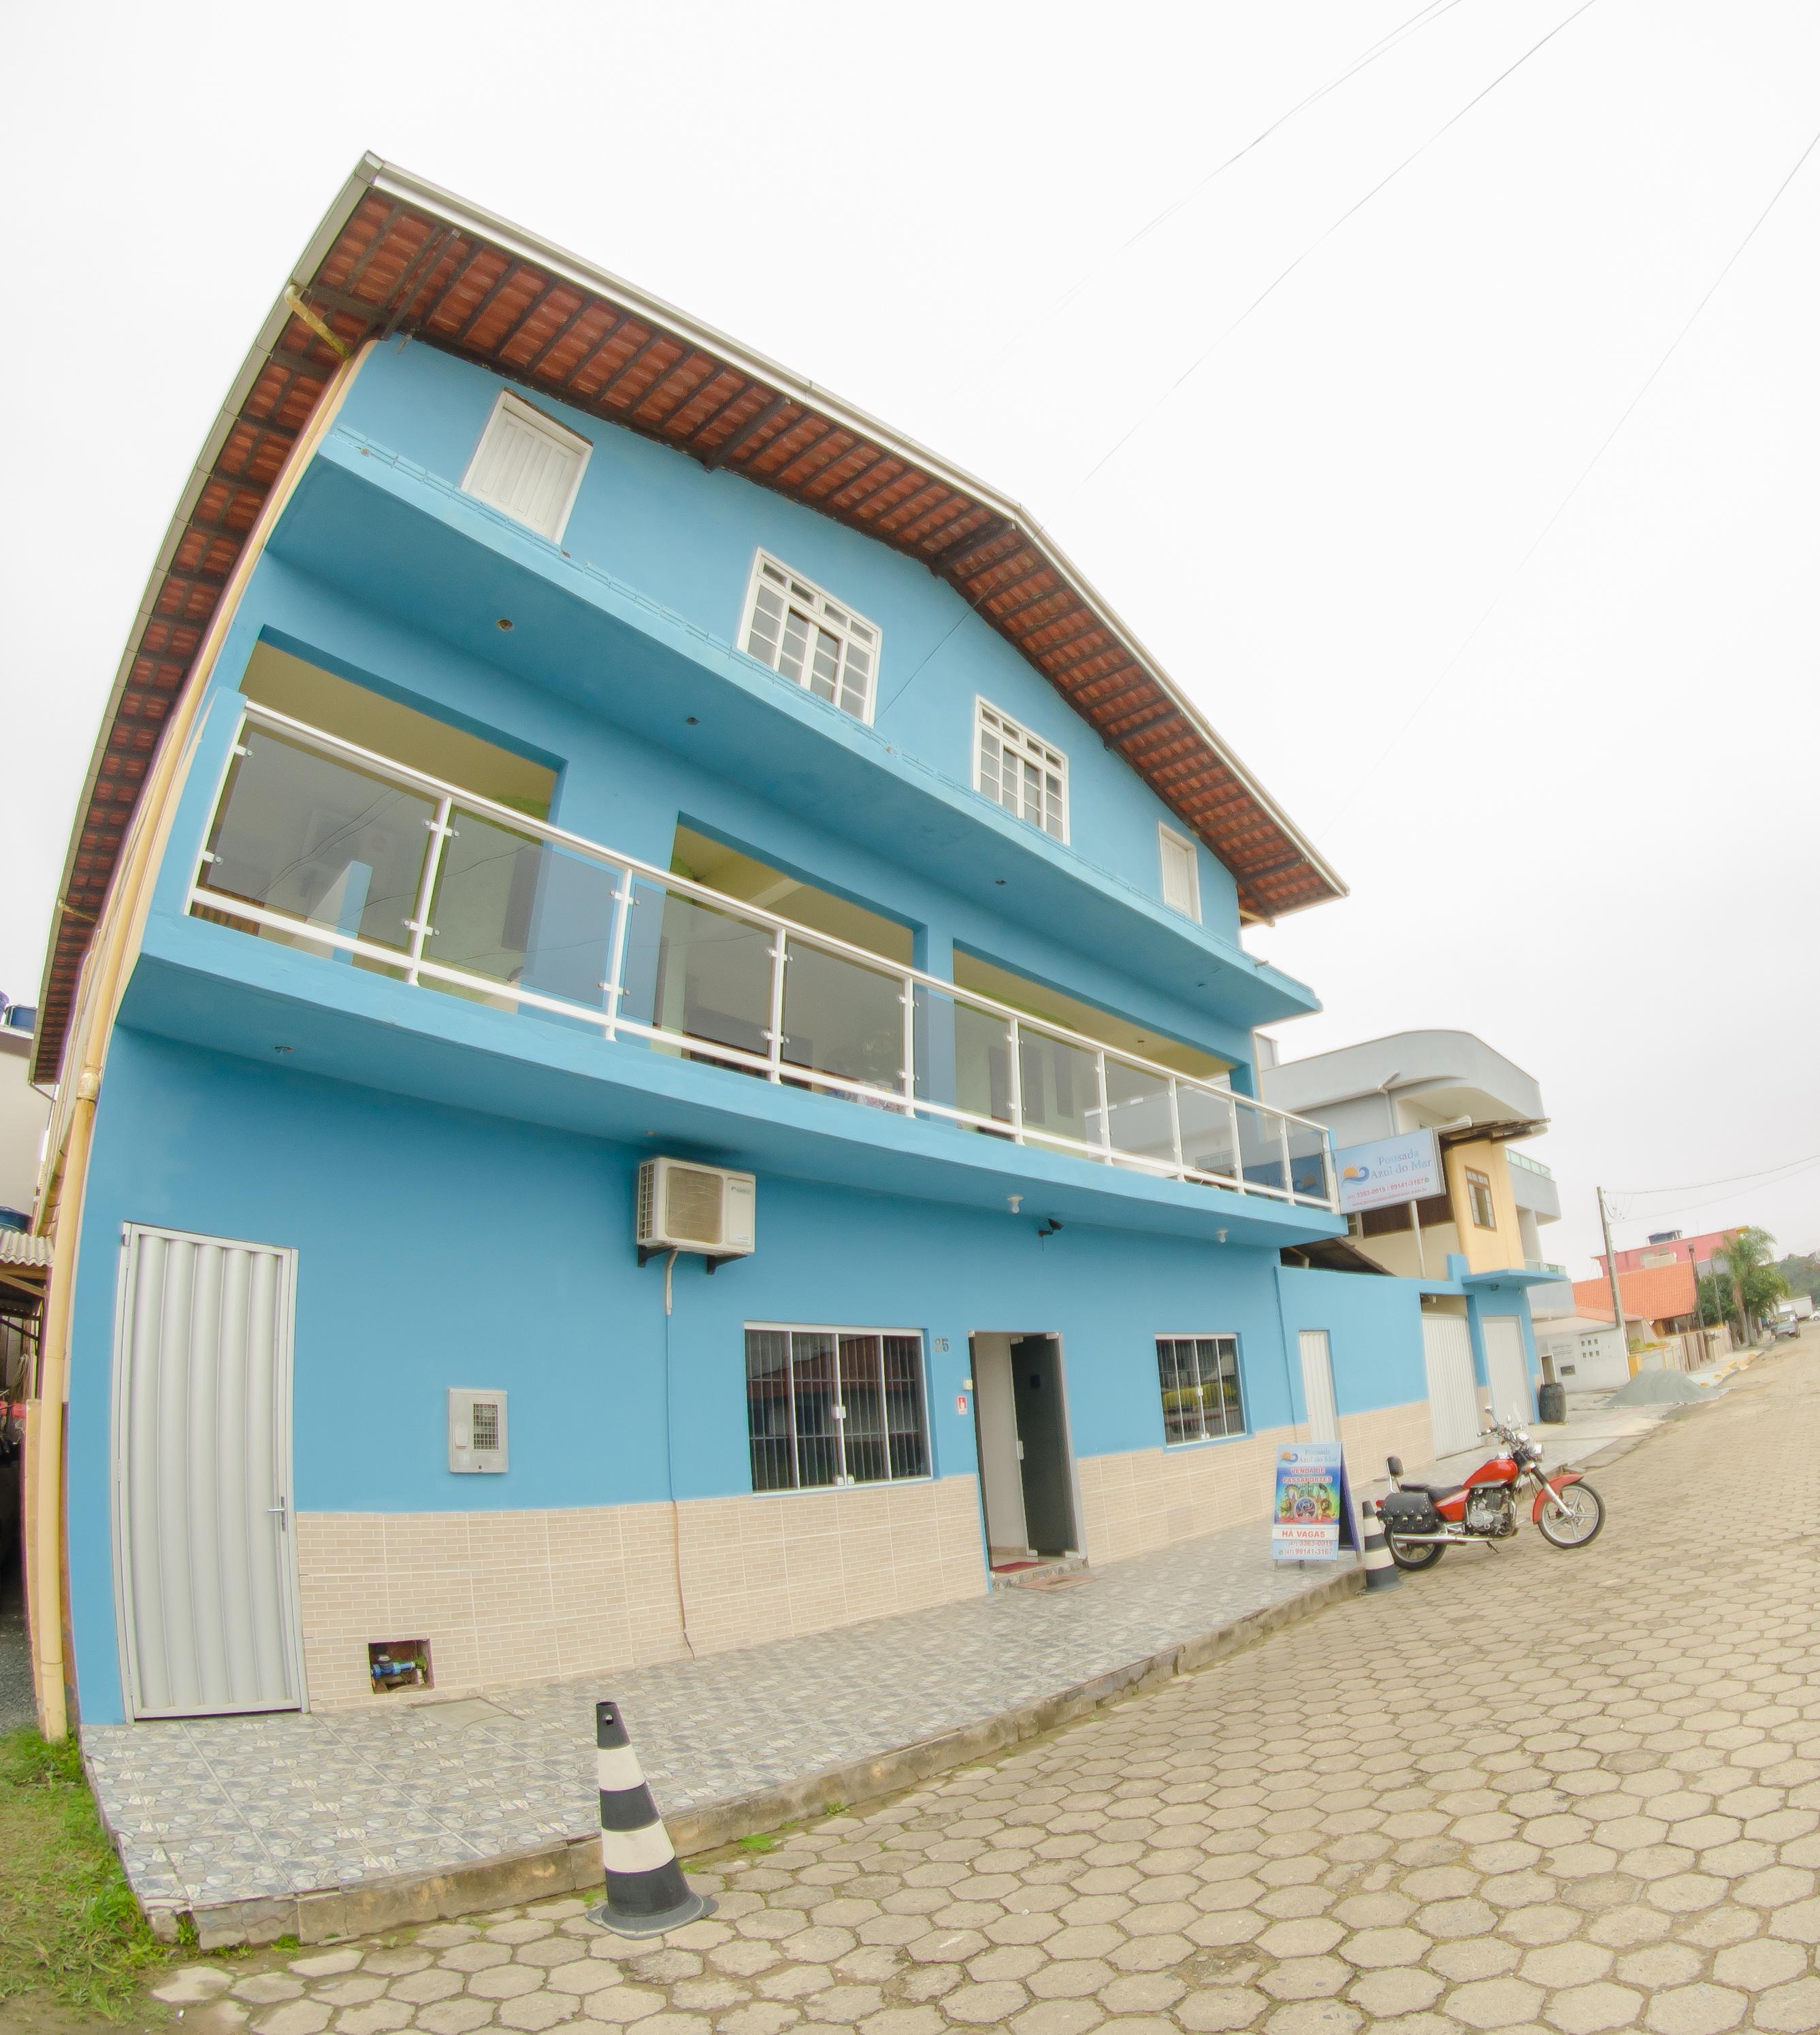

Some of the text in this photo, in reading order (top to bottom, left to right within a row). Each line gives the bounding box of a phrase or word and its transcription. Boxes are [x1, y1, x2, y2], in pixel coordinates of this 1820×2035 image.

[1378, 1148, 1419, 1166] Pousada
[1371, 1159, 1432, 1179] Azul do Mar
[1282, 1529, 1294, 1537] HÁ
